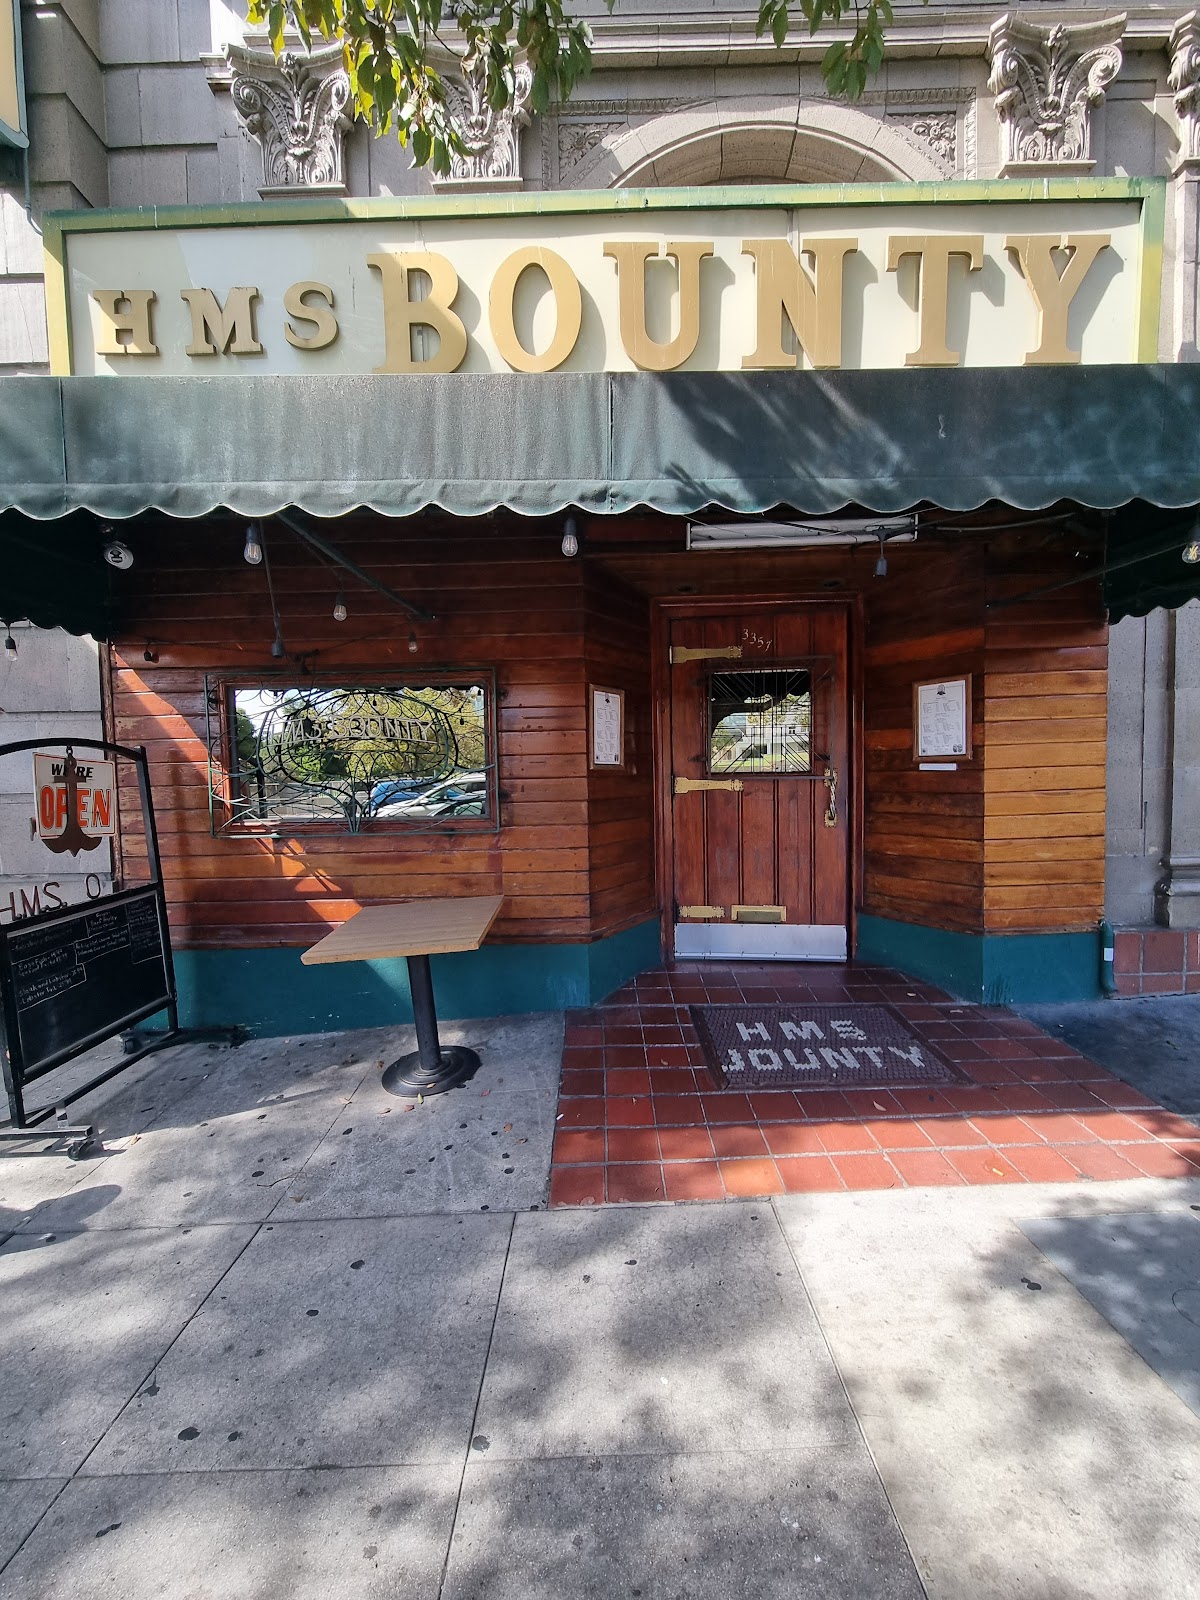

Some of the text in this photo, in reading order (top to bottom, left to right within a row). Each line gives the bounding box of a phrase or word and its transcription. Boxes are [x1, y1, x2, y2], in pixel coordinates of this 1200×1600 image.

[366, 233, 1112, 374] BOUNTY
[741, 628, 773, 652] 3357
[329, 714, 434, 743] BOUNTY
[40, 784, 111, 830] OPEN
[735, 1019, 867, 1042] HMS
